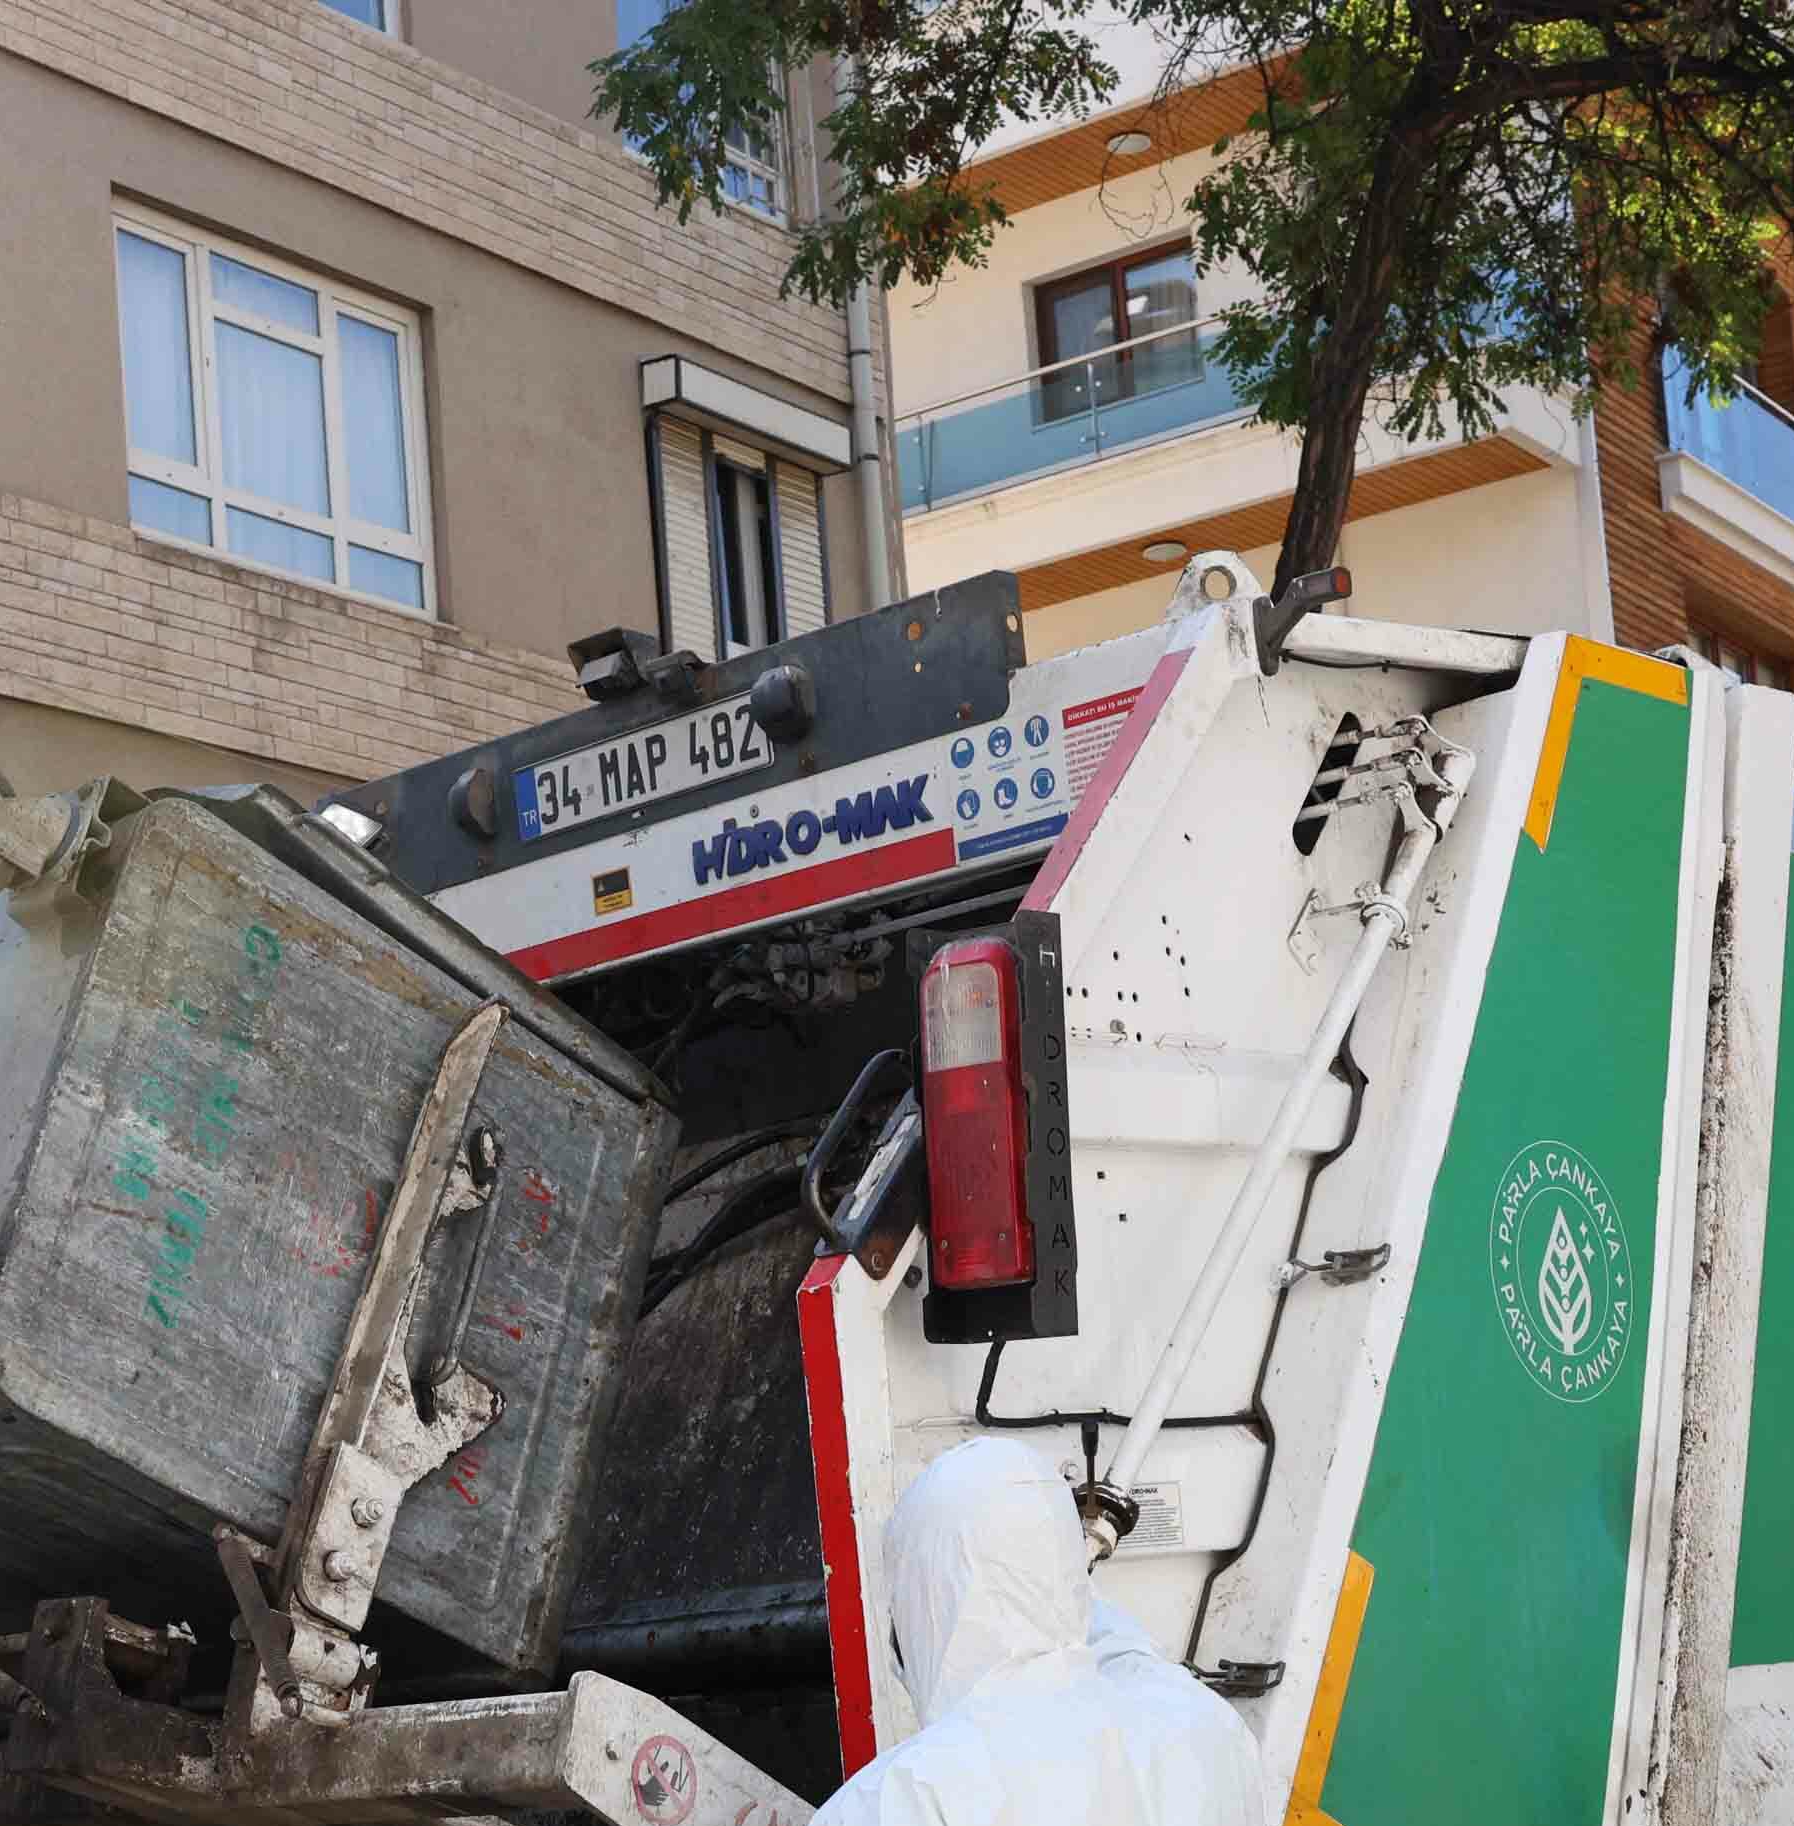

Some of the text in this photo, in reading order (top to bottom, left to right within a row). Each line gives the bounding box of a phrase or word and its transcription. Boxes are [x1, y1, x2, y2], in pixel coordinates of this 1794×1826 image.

[537, 704, 762, 826] 34 MAP 482
[519, 808, 538, 827] TR
[1545, 1152, 1622, 1260] ÇANKAYA
[1559, 1299, 1629, 1393] ÇANKAYA
